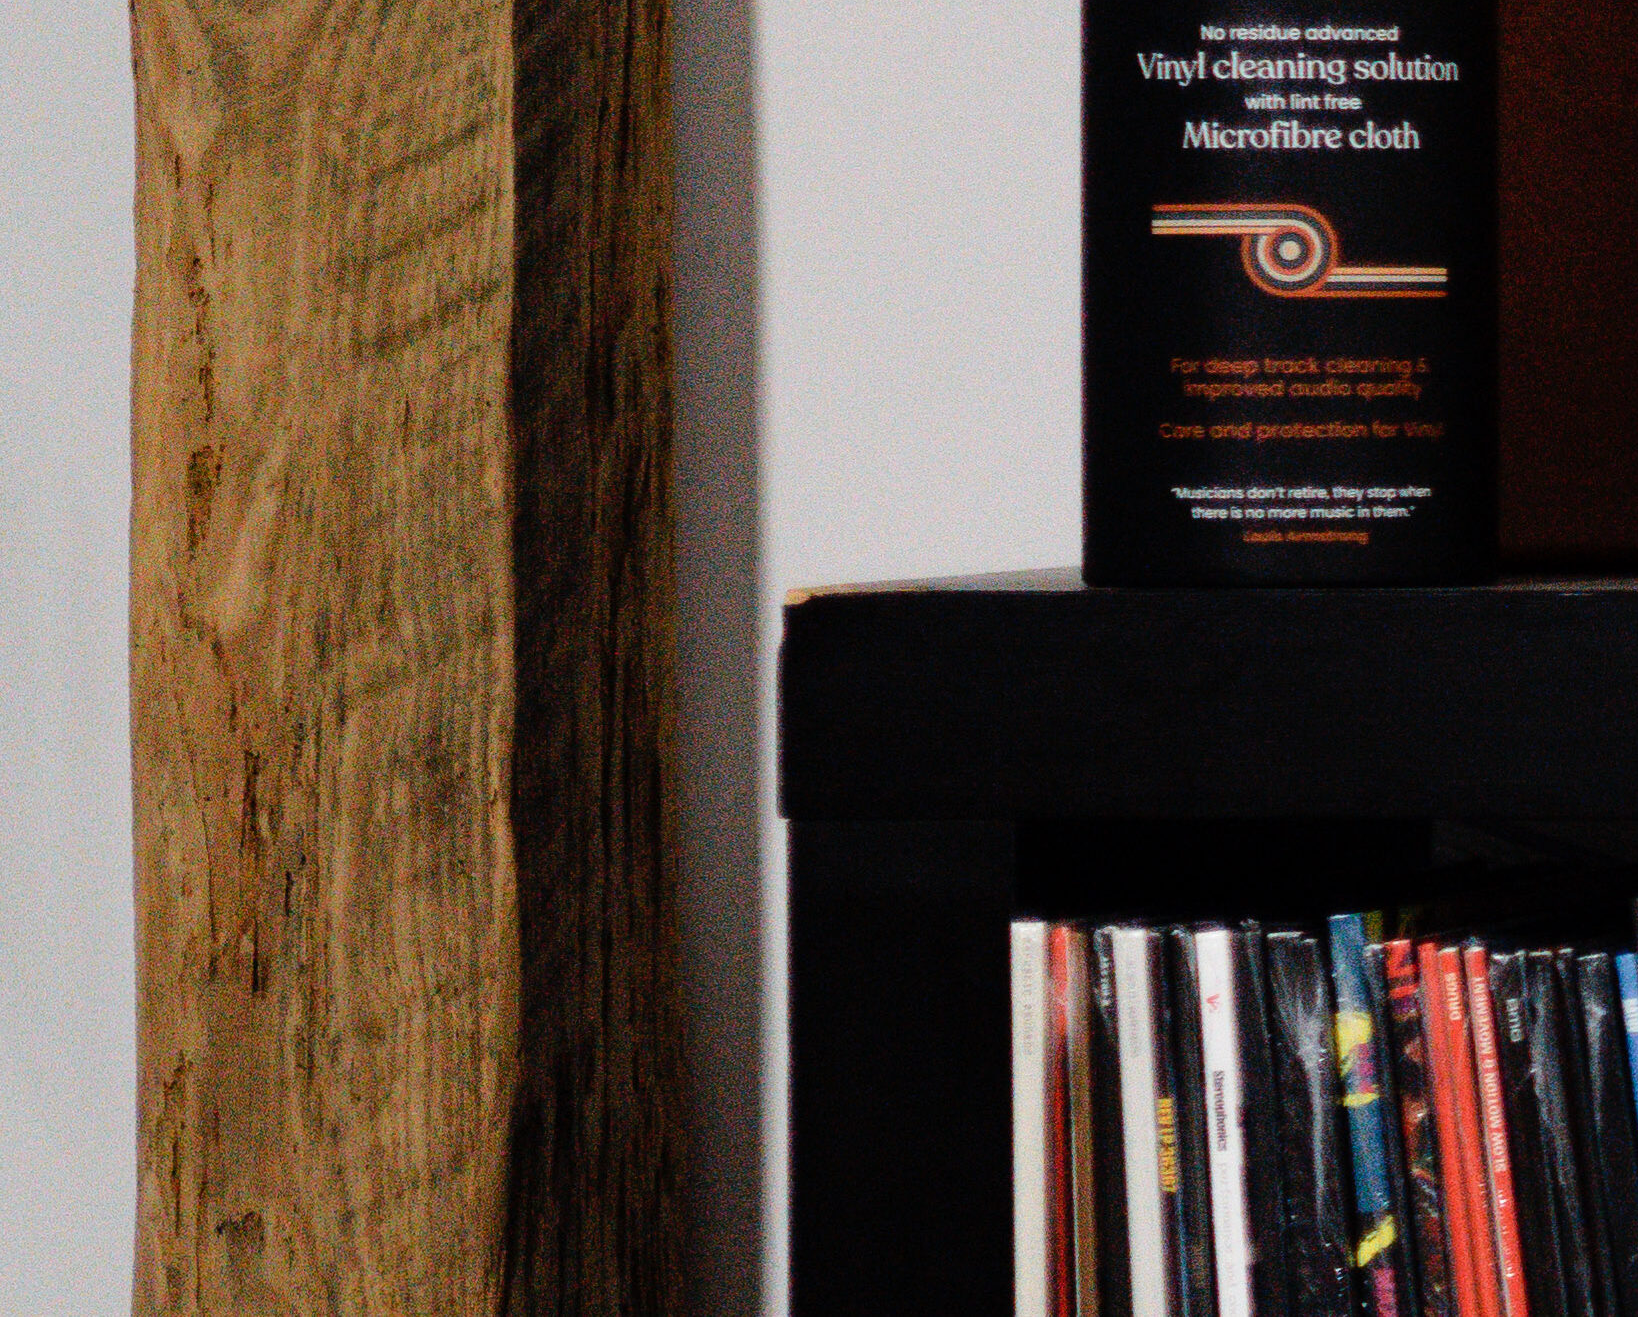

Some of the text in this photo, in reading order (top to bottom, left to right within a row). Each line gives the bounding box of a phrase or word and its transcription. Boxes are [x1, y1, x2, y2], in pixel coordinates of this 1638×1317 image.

[1200, 24, 1400, 41] No residue advanced
[1138, 52, 1460, 86] Vinyl cleaning solution
[1244, 94, 1363, 110] with lint free
[1183, 121, 1420, 150] Microfibre cloth
[1203, 358, 1258, 378] deep
[1264, 358, 1319, 374] track
[1325, 358, 1412, 378] cleaning
[1289, 380, 1350, 397] audio
[1356, 380, 1421, 400] quality
[1159, 422, 1399, 443] Care and protection for
[1333, 487, 1364, 502] they
[1366, 487, 1397, 502] stop
[1399, 486, 1431, 498] when
[1191, 505, 1370, 519] there is no more music in
[1444, 973, 1463, 1021] DRUGS
[1472, 975, 1509, 1173] SLOW MOTION MOVEMENT
[1212, 1070, 1229, 1153] Stereophonics
